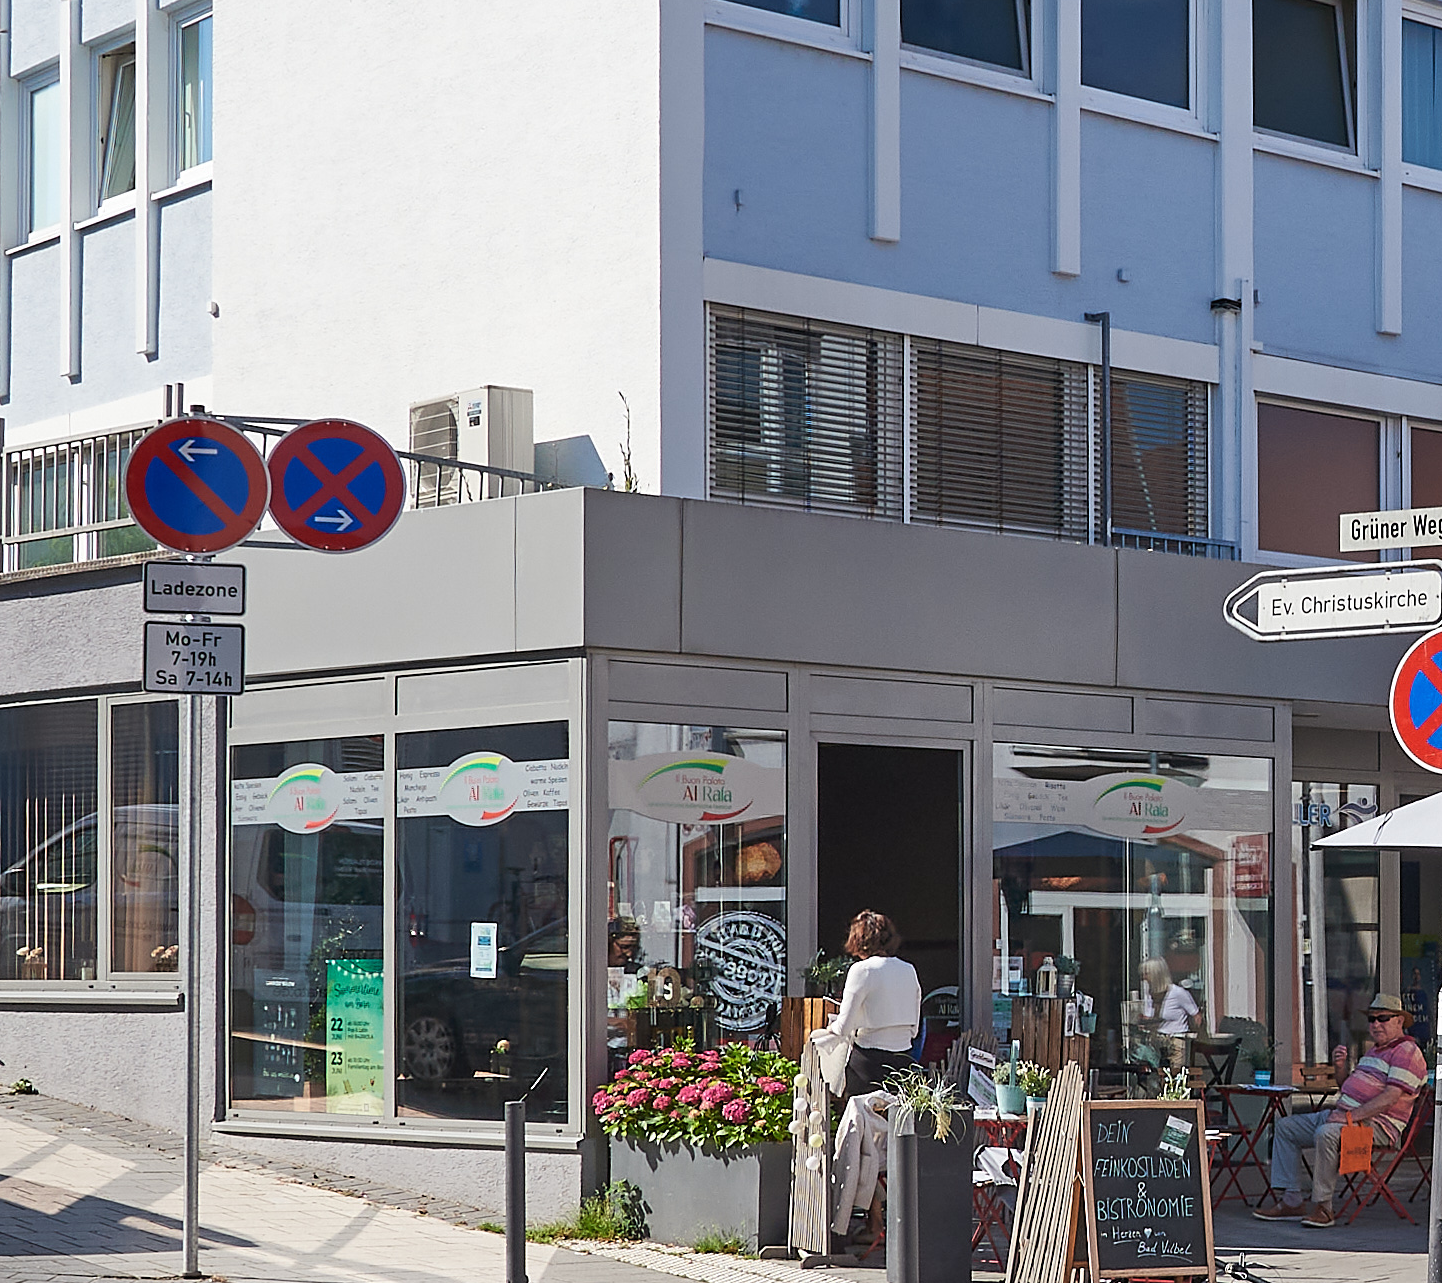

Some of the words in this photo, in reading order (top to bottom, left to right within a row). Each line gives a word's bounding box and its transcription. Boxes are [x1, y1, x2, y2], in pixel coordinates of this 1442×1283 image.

[1351, 519, 1407, 540] Grüner
[151, 579, 238, 597] Ladezone
[1272, 598, 1295, 616] Ev.
[1301, 589, 1428, 614] Christuskirche
[165, 630, 222, 647] Mo-Fr
[171, 651, 216, 667] 7-19h
[155, 670, 177, 685] Sa
[186, 671, 233, 687] 7-14h
[420, 771, 440, 779] Espresso
[682, 785, 698, 802] Al
[1129, 802, 1142, 816] Al
[330, 1017, 343, 1032] 22
[331, 1052, 343, 1066] 23
[1096, 1120, 1135, 1145] DEIN
[1094, 1156, 1191, 1180] FEINKOSTLADEN
[1137, 1182, 1147, 1199] &
[1096, 1194, 1194, 1222] BISTRONOMIE
[1112, 1225, 1142, 1240] Herzen
[1137, 1242, 1157, 1254] Bad
[1161, 1239, 1193, 1255] Vilbel
